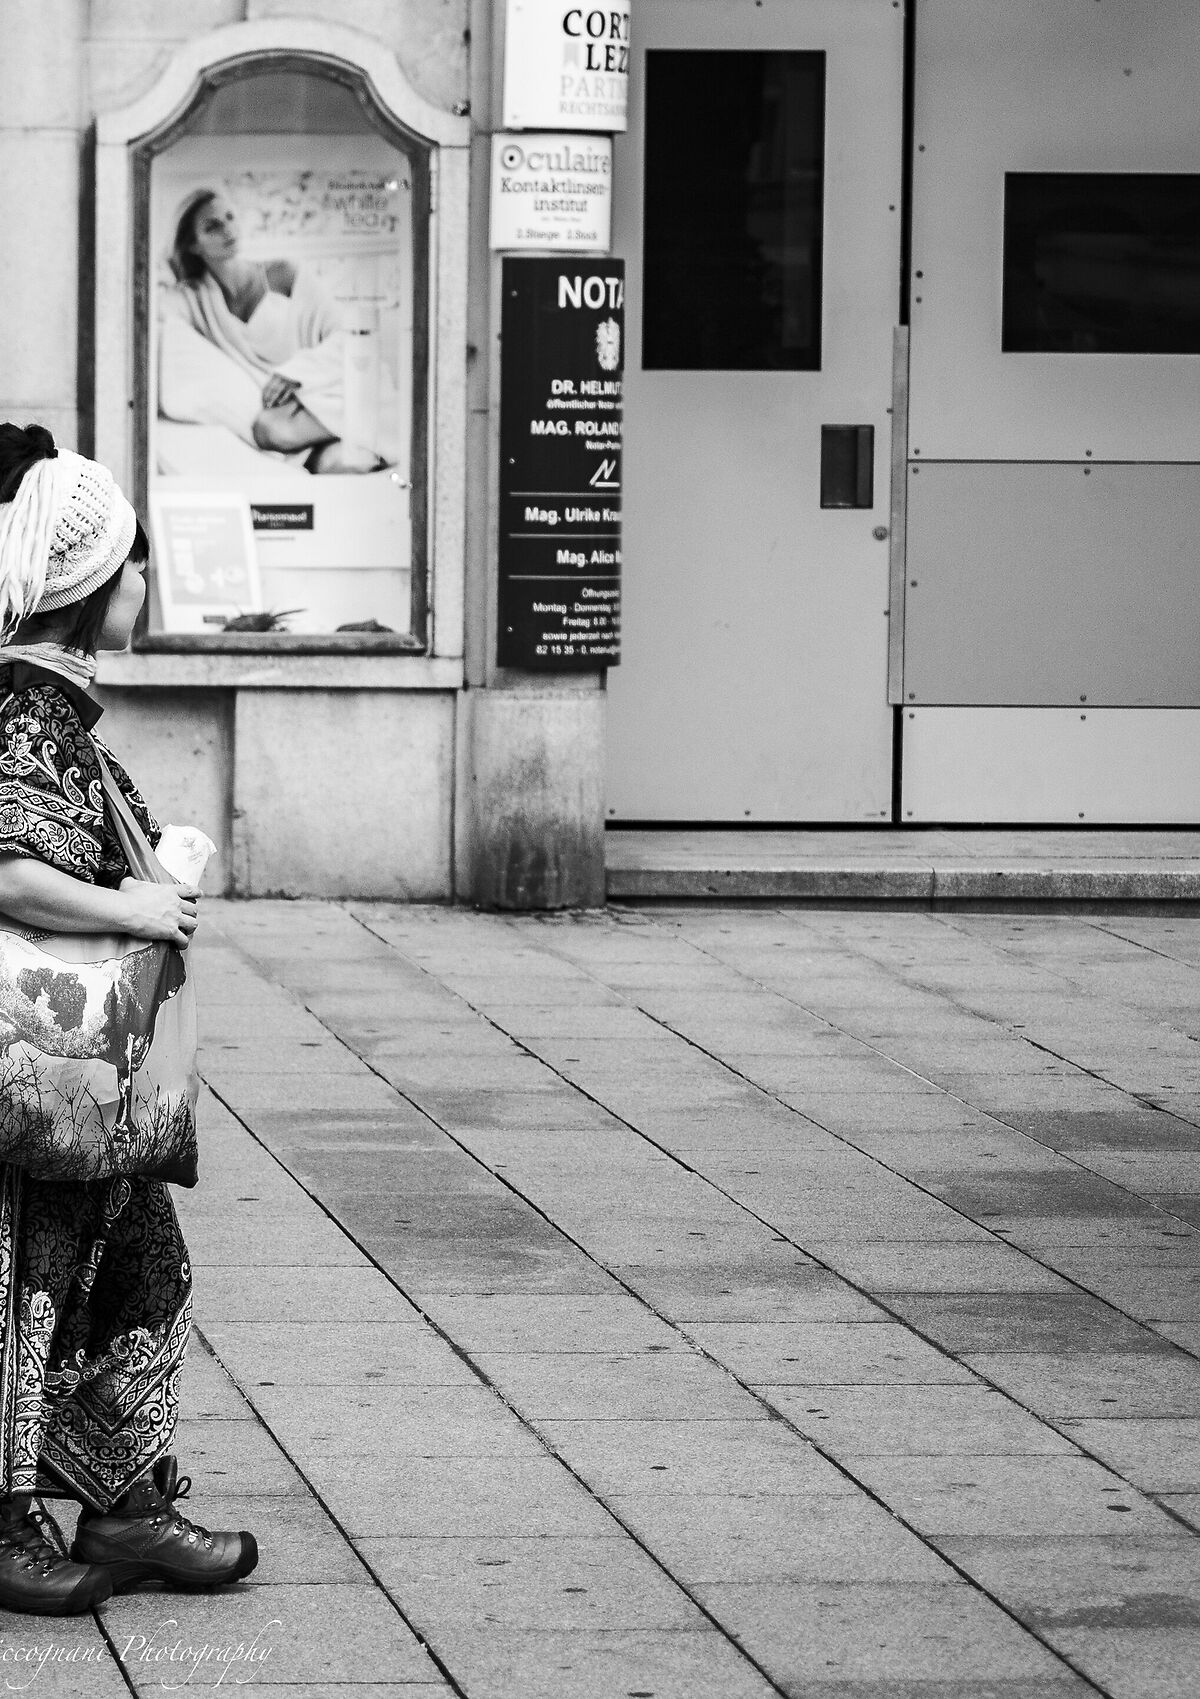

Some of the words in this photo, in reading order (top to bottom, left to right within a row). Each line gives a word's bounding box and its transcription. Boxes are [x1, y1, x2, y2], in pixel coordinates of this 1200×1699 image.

[551, 379, 577, 395] DR.
[530, 420, 572, 435] MAG.
[525, 507, 562, 525] Mag.
[557, 549, 589, 568] Mag.
